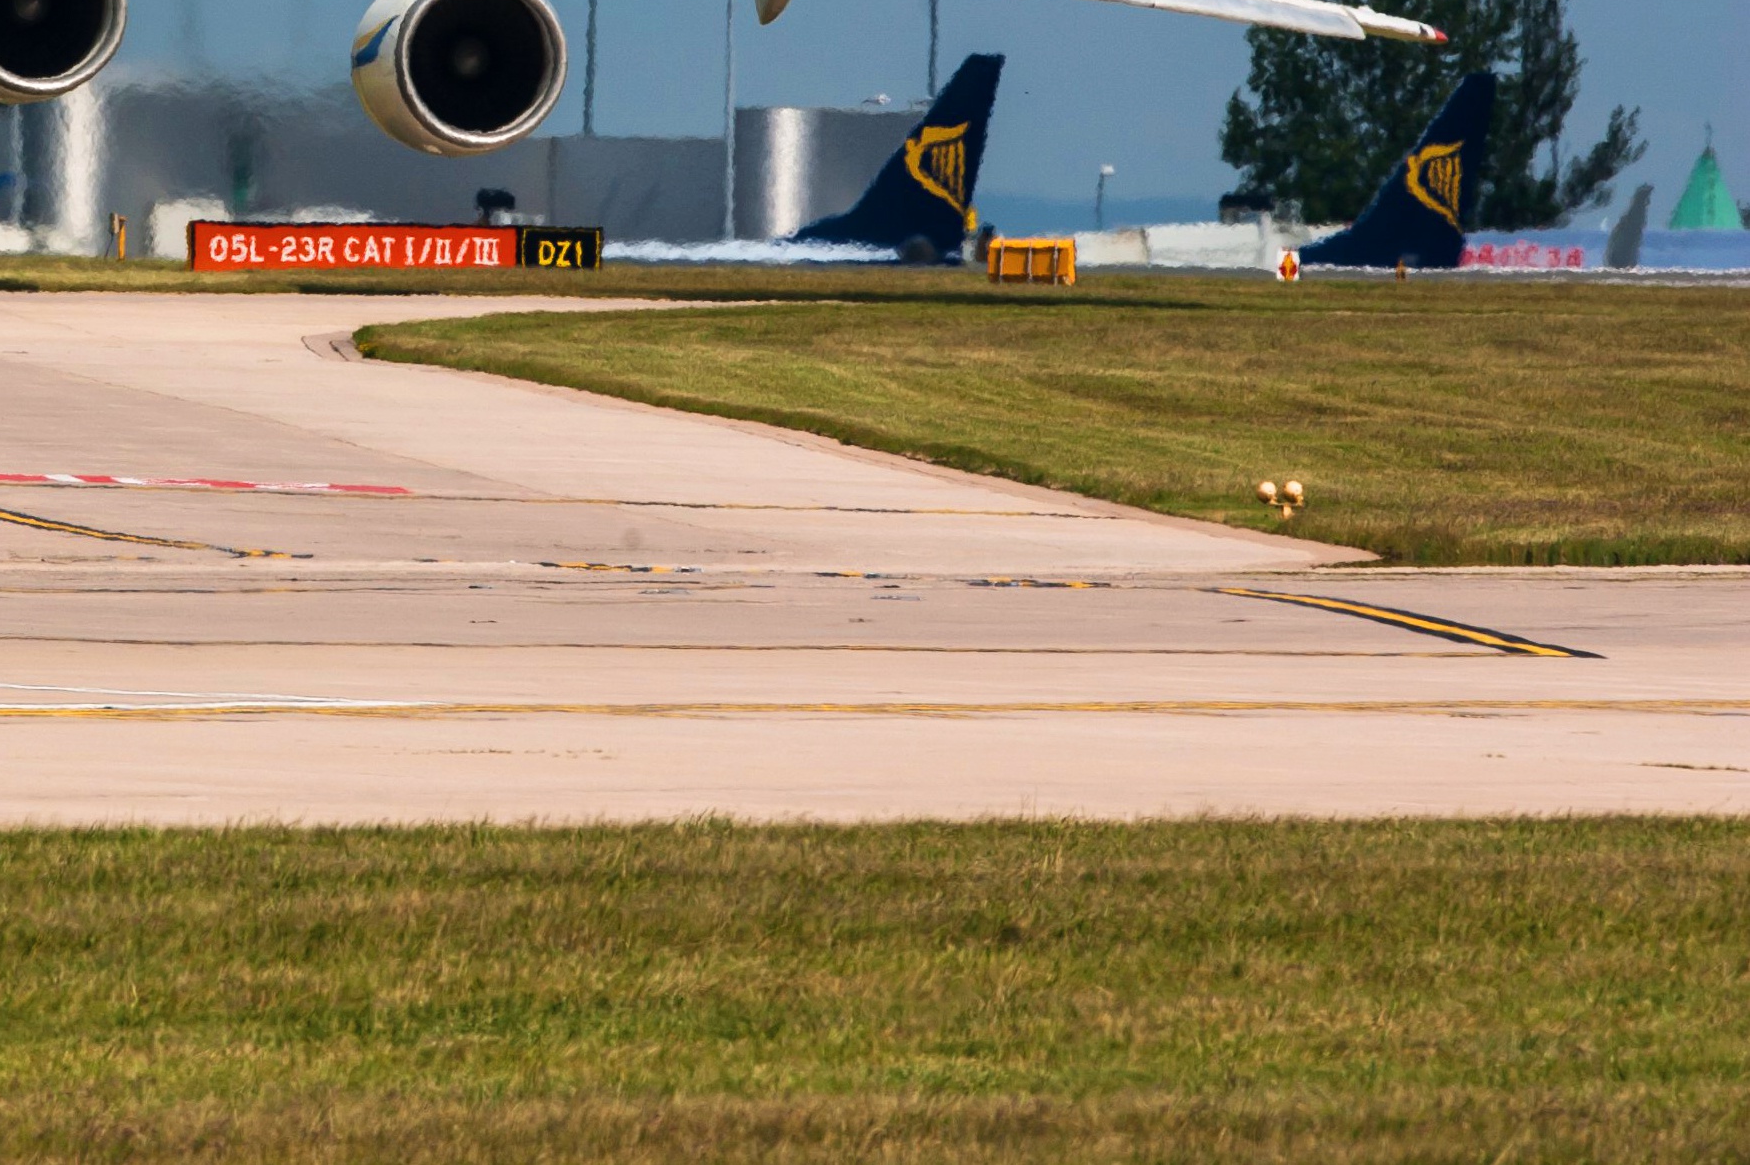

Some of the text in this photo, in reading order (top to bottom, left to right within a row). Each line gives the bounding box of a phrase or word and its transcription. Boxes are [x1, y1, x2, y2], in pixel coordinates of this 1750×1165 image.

[209, 234, 500, 265] 05L-23R CAT I/II/III
